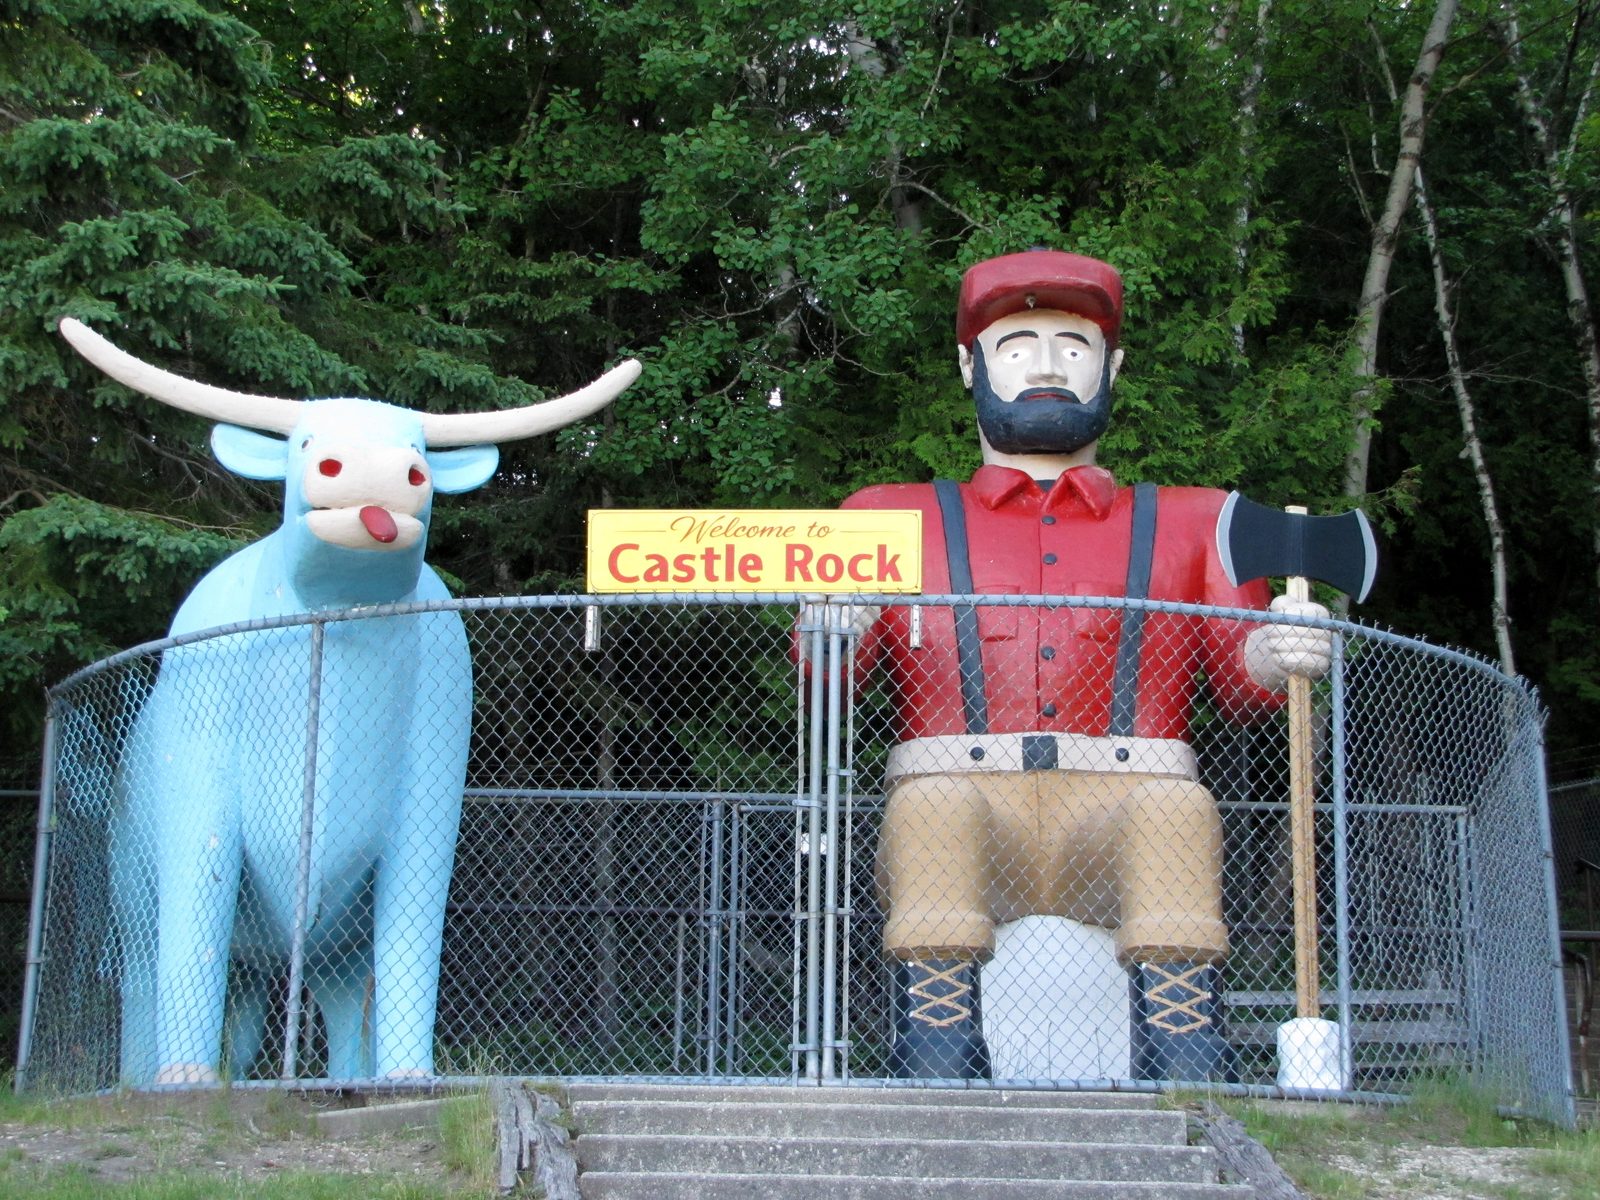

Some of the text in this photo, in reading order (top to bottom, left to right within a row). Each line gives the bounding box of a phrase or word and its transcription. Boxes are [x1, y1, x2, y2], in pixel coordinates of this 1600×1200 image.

[670, 515, 835, 545] Welcome to
[608, 543, 903, 583] Castle Rock
